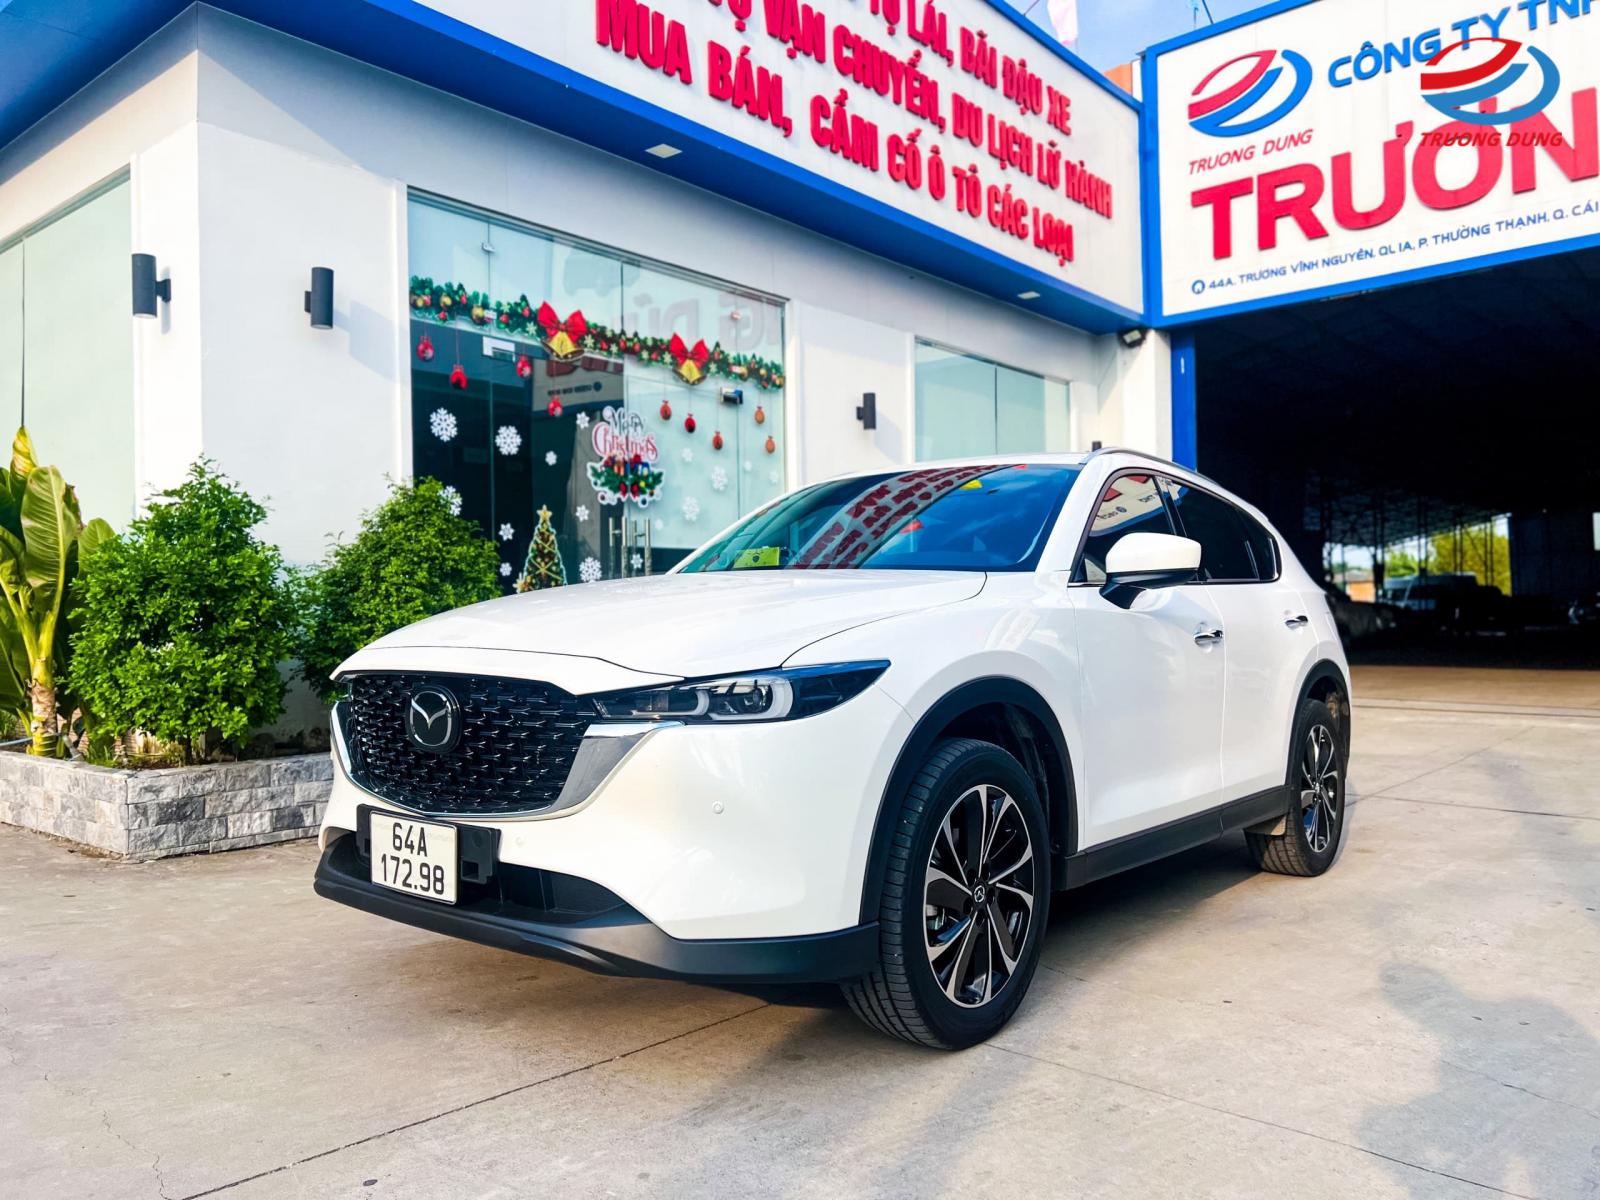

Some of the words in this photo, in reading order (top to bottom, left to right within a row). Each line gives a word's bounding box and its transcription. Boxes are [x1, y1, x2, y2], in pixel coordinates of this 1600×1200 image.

[959, 26, 998, 89] BÃI
[1001, 55, 1043, 116] ĐẬU
[1046, 85, 1072, 136] XE
[1328, 27, 1442, 88] CÔNG
[1451, 6, 1511, 50] TY
[596, 0, 693, 85] MUA
[707, 40, 793, 137] BÁN,
[887, 128, 922, 190] CỐ
[928, 144, 946, 200] Ô
[952, 163, 982, 218] TÔ
[987, 184, 1029, 240] CÁC
[1033, 207, 1074, 267] LOẠI
[833, 24, 946, 134] CHUYỂN,
[952, 92, 983, 148] DU
[987, 113, 1033, 176] LỊCH
[1065, 160, 1113, 219] HÀNH
[1188, 144, 1256, 176] TRUONG
[1262, 128, 1314, 156] DUNG
[381, 853, 445, 895] 172.98
[392, 822, 428, 857] 64A
